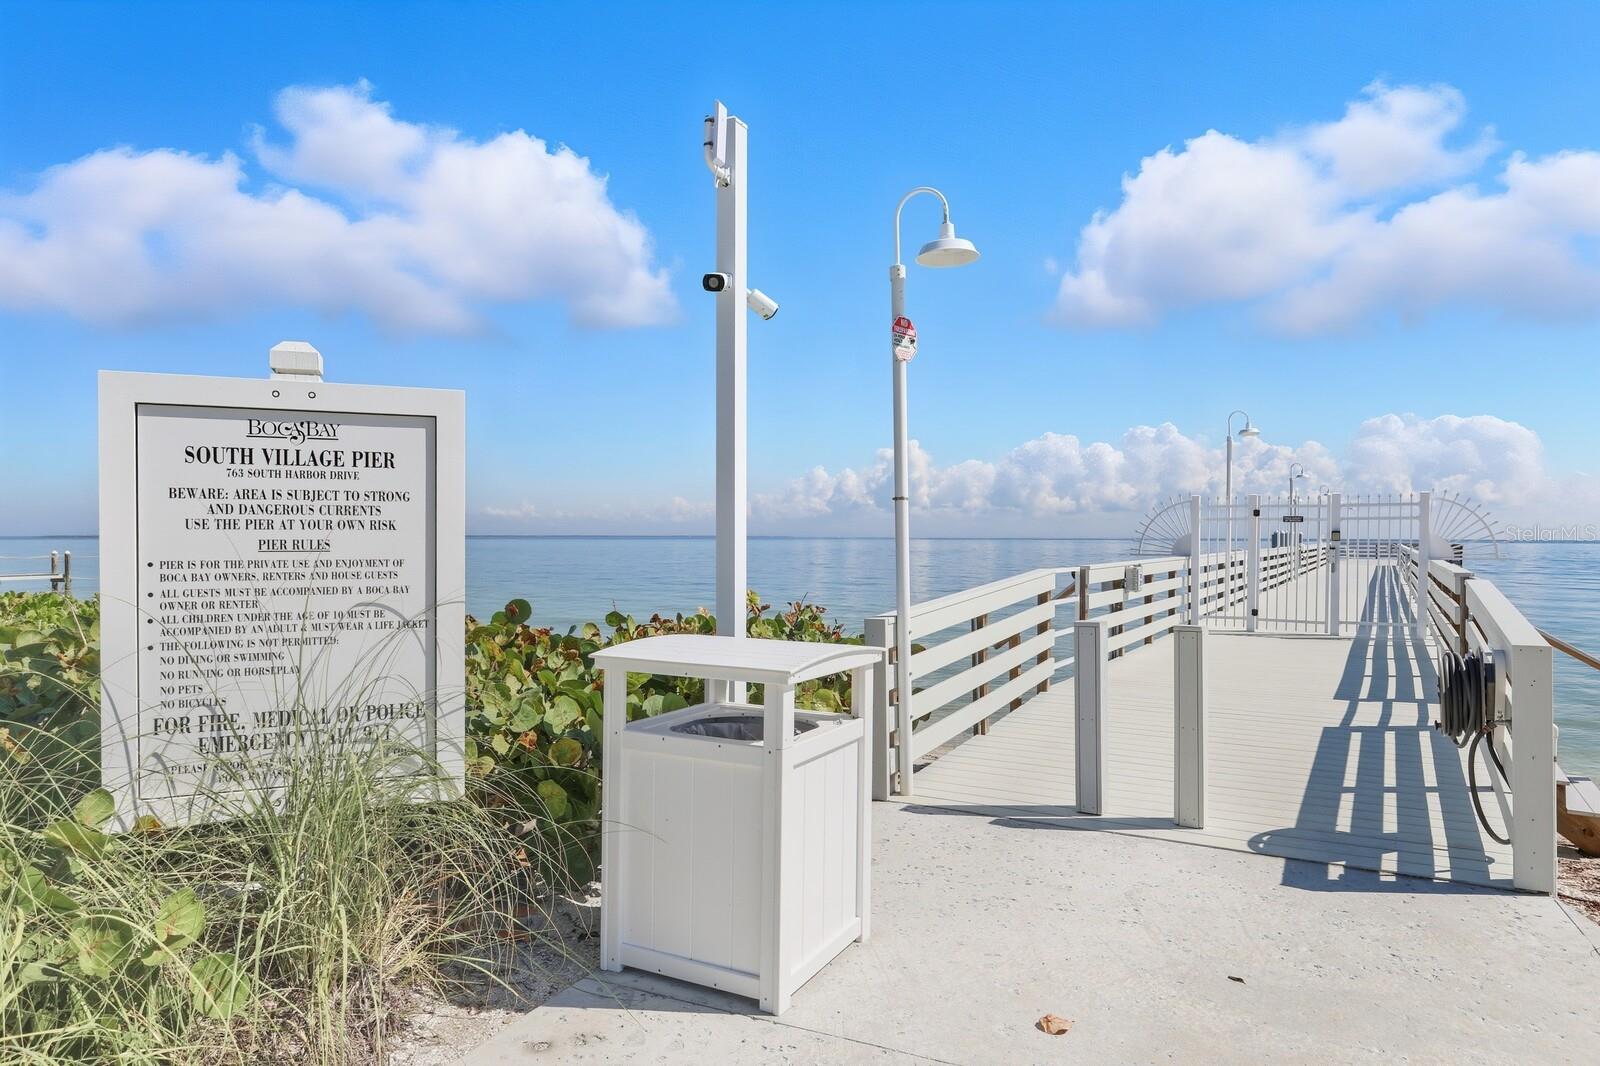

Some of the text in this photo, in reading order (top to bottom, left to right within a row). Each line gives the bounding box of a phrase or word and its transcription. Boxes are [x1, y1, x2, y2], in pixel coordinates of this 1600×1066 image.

[184, 445, 396, 469] SOUTH VILLAGE PIER
[226, 468, 360, 481] 763 SOUTH HARBOR DRIVE
[168, 487, 411, 503] BEWARE: AREA IS SUBJECT TO STRONG
[206, 503, 382, 517] AND DANGEROUS CURRENTS
[185, 518, 397, 532] USE THE PIER AT YOUR OWN RISK
[258, 538, 331, 551] PIER RULES
[159, 559, 405, 570] PIER IS FOR THE PRIVATE USE AND ENJOYMENT OF
[159, 573, 187, 582] BOCA
[191, 573, 211, 582] BAY
[262, 571, 306, 581] RENTERS
[309, 571, 328, 580] AND
[331, 571, 362, 580] HOUSE
[364, 570, 398, 580] GUESTS
[160, 585, 410, 599] ALL GUESTS MUST BE ACCOMPANIED BY A BOCA BAY
[159, 600, 258, 611] OWNER OR RENTER
[160, 609, 385, 624] ALL CHILDREN UNDER THE AGE OF 10 MUST BE
[160, 625, 232, 637] ACCOMPANIED
[235, 625, 247, 635] BY
[251, 624, 264, 634] AN
[267, 623, 298, 634] ADULT
[311, 622, 335, 632] MUST
[338, 621, 364, 631] WEAR
[367, 621, 373, 631] A
[375, 620, 394, 630] LIFE
[396, 619, 429, 630] JACKET
[159, 641, 181, 652] THE
[184, 640, 244, 651] FOLLOWING
[247, 639, 256, 648] IS
[259, 638, 278, 648] NOT
[160, 651, 285, 665] NO DIVING OR SWIMMING
[160, 665, 300, 681] NO RUNNING OR HORSEPLAY
[160, 684, 203, 695] NO PETS
[160, 700, 175, 709] NO
[153, 716, 191, 735] FOR
[366, 702, 426, 721] POLICE
